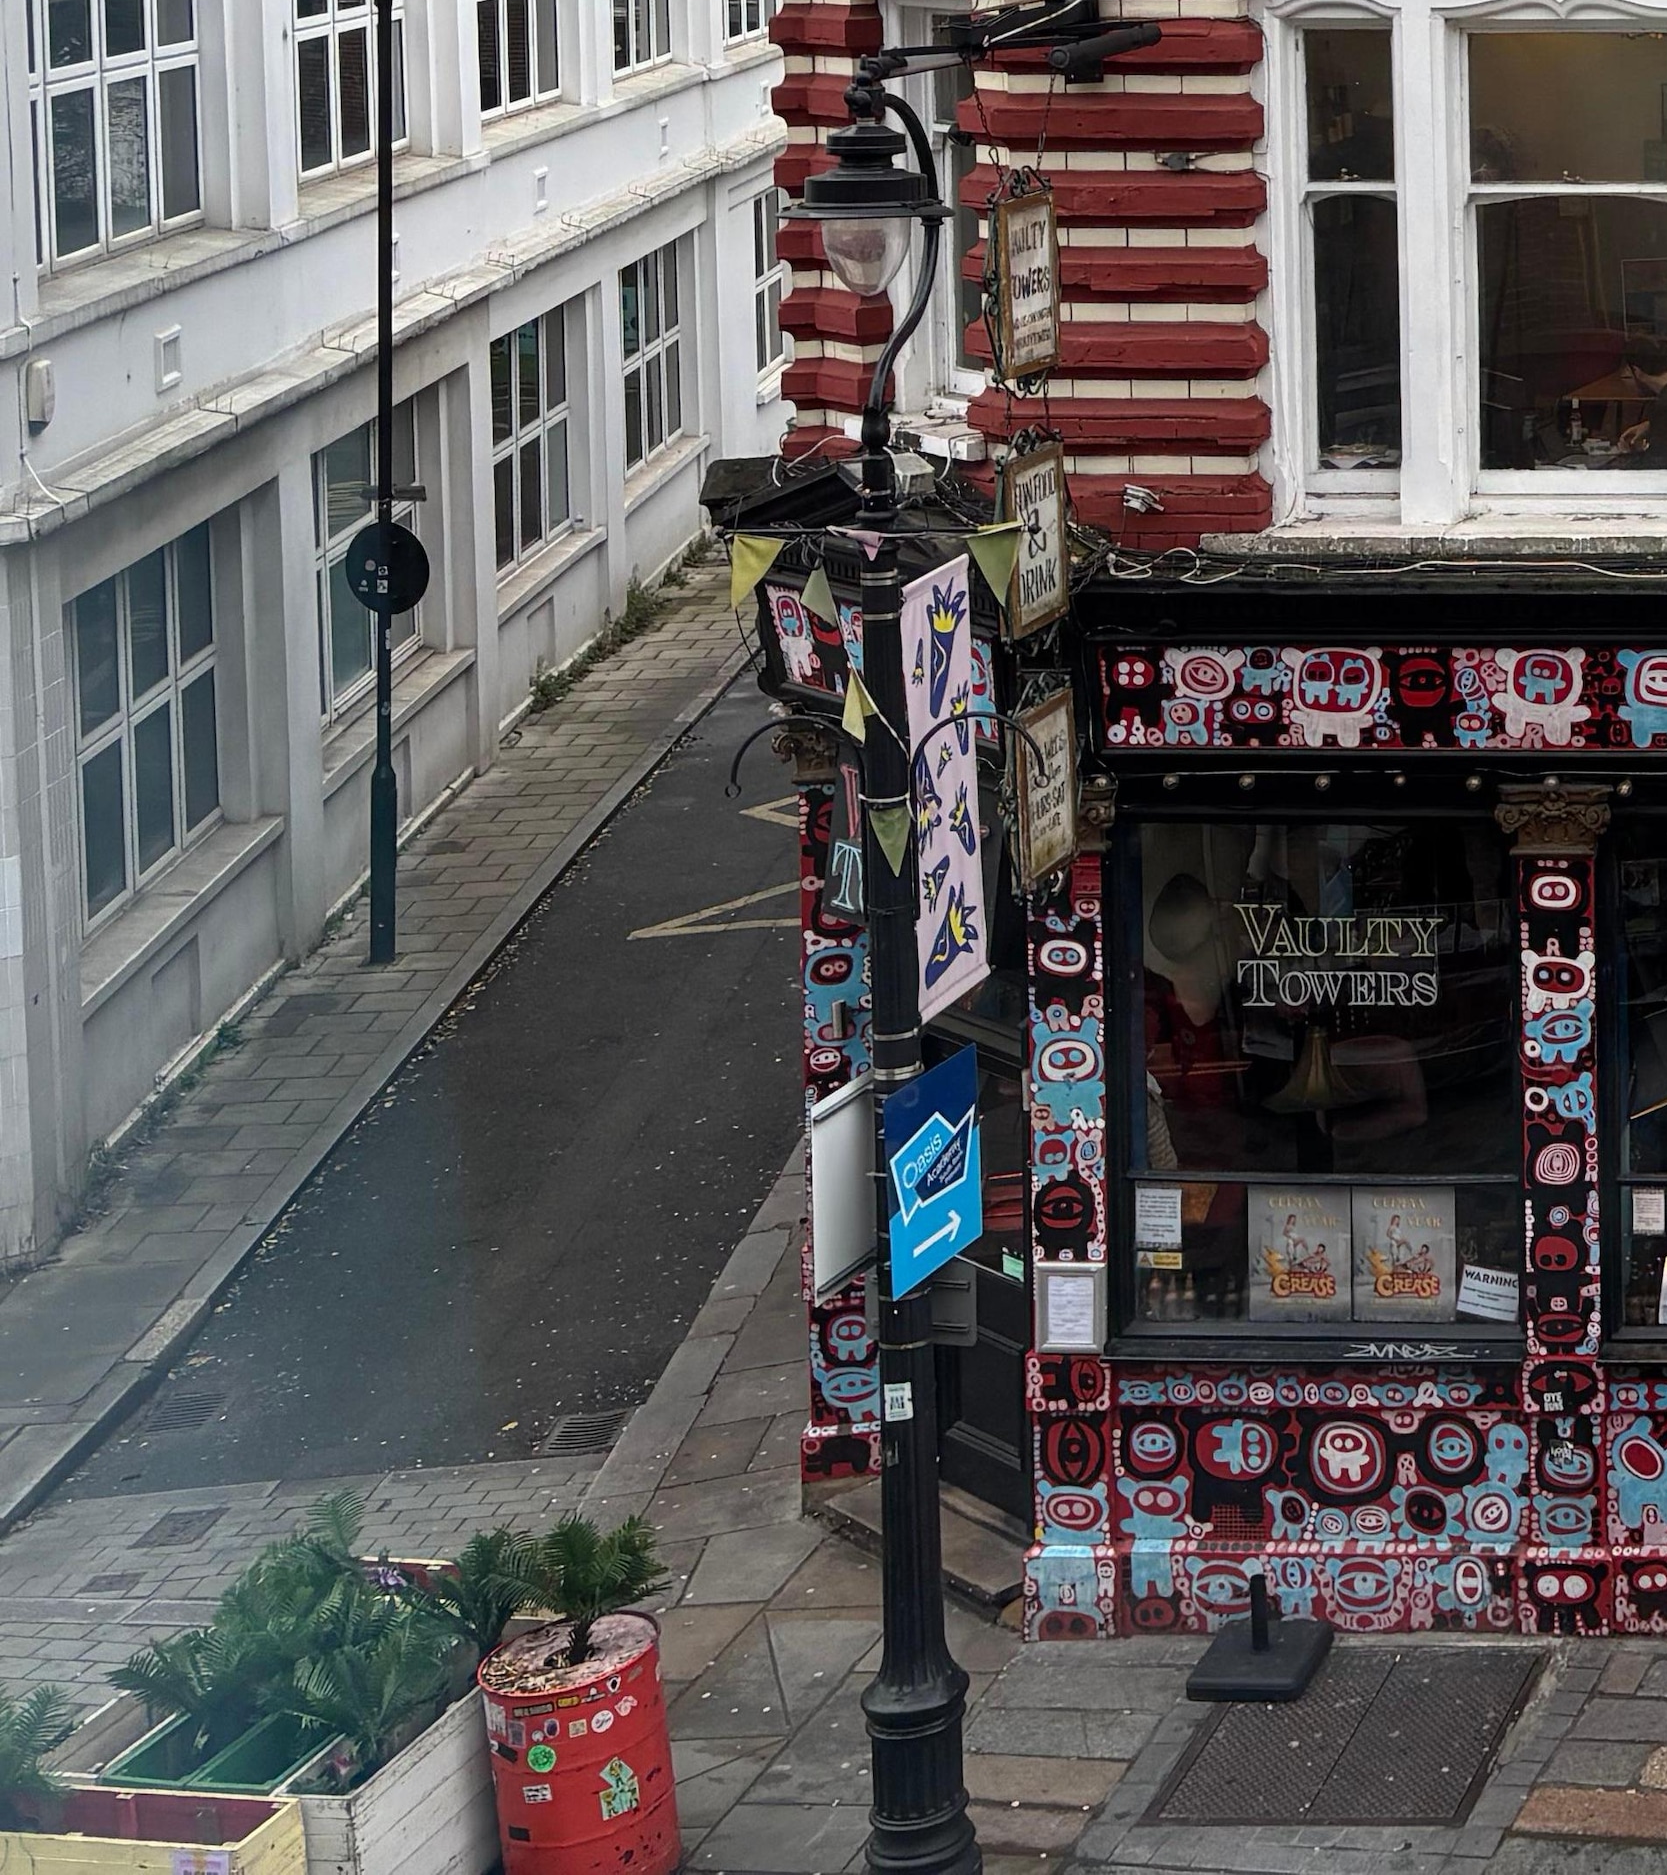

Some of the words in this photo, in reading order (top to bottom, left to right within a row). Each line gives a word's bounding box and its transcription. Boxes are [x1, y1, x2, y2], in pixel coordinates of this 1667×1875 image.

[1011, 220, 1047, 258] AULTY
[1233, 903, 1444, 957] VAULTY
[1237, 960, 1438, 1006] TOWERS
[903, 1134, 942, 1189] Oasis
[1465, 1269, 1519, 1288] WARNING
